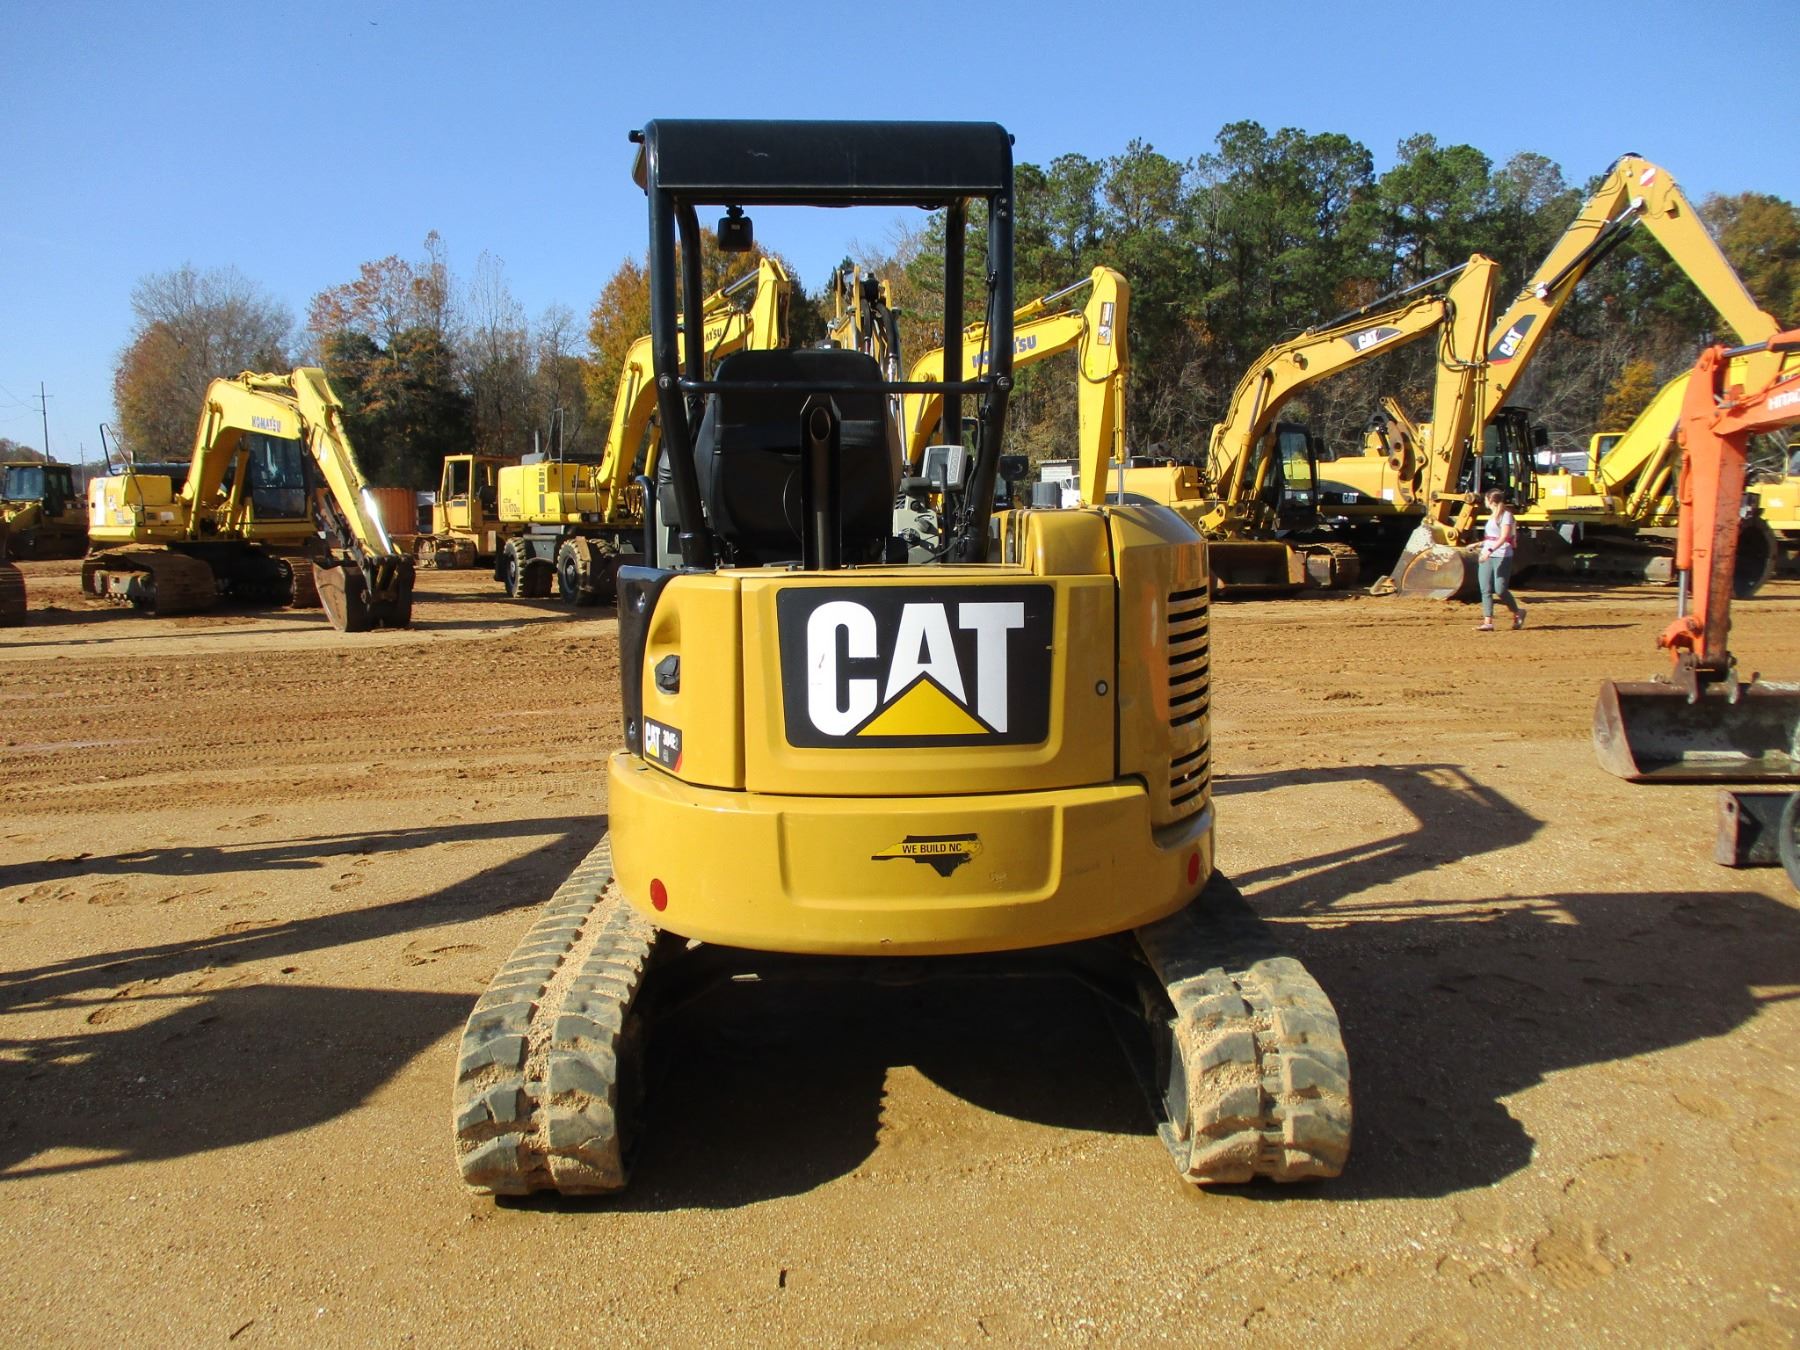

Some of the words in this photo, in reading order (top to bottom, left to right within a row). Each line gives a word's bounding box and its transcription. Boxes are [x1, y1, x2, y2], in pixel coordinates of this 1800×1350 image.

[972, 334, 1037, 368] KOTSU
[1358, 330, 1378, 350] CAT
[1500, 327, 1523, 357] CAT
[252, 415, 281, 432] KOMATSU
[807, 601, 1025, 737] CAT
[645, 721, 661, 759] CAT
[903, 844, 917, 853] WE
[920, 844, 946, 853] BUILD
[949, 843, 962, 852] NC
